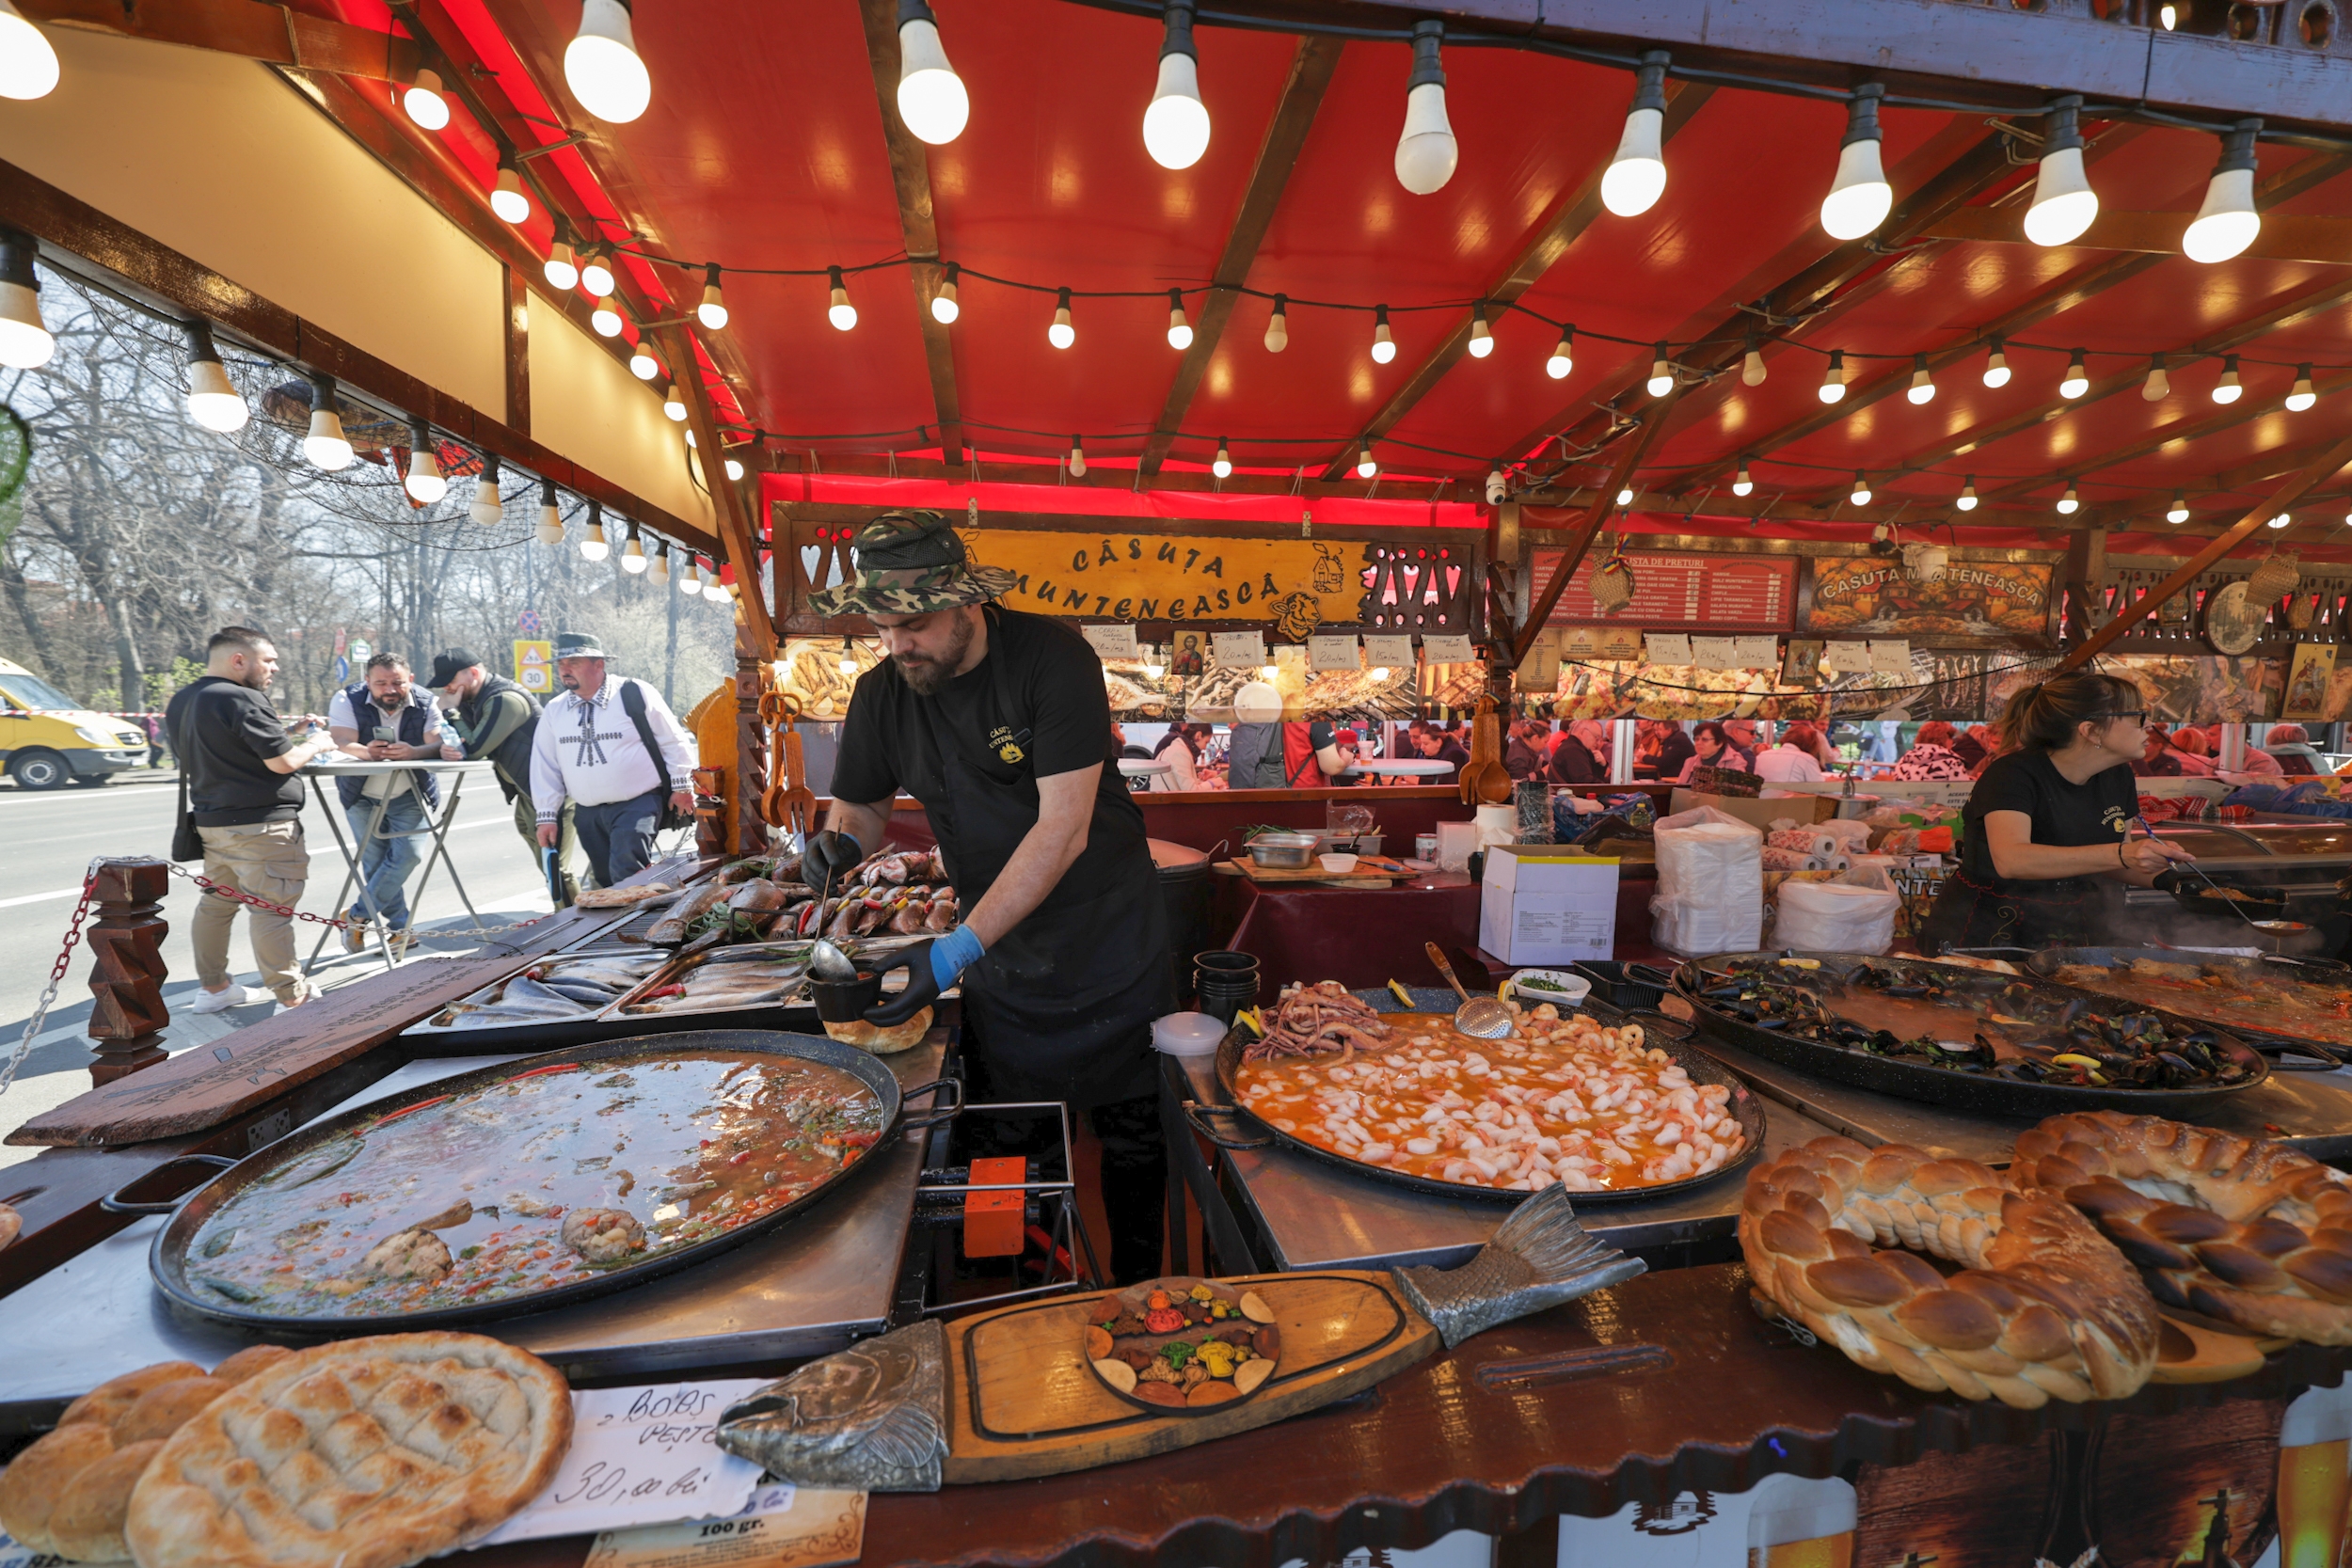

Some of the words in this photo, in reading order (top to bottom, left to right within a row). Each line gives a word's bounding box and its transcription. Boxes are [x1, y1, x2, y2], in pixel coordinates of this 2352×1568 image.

[1823, 568, 1900, 599] CASUTA
[528, 673, 541, 683] 30
[700, 1522, 735, 1537] 100
[738, 1518, 764, 1534] gr.
